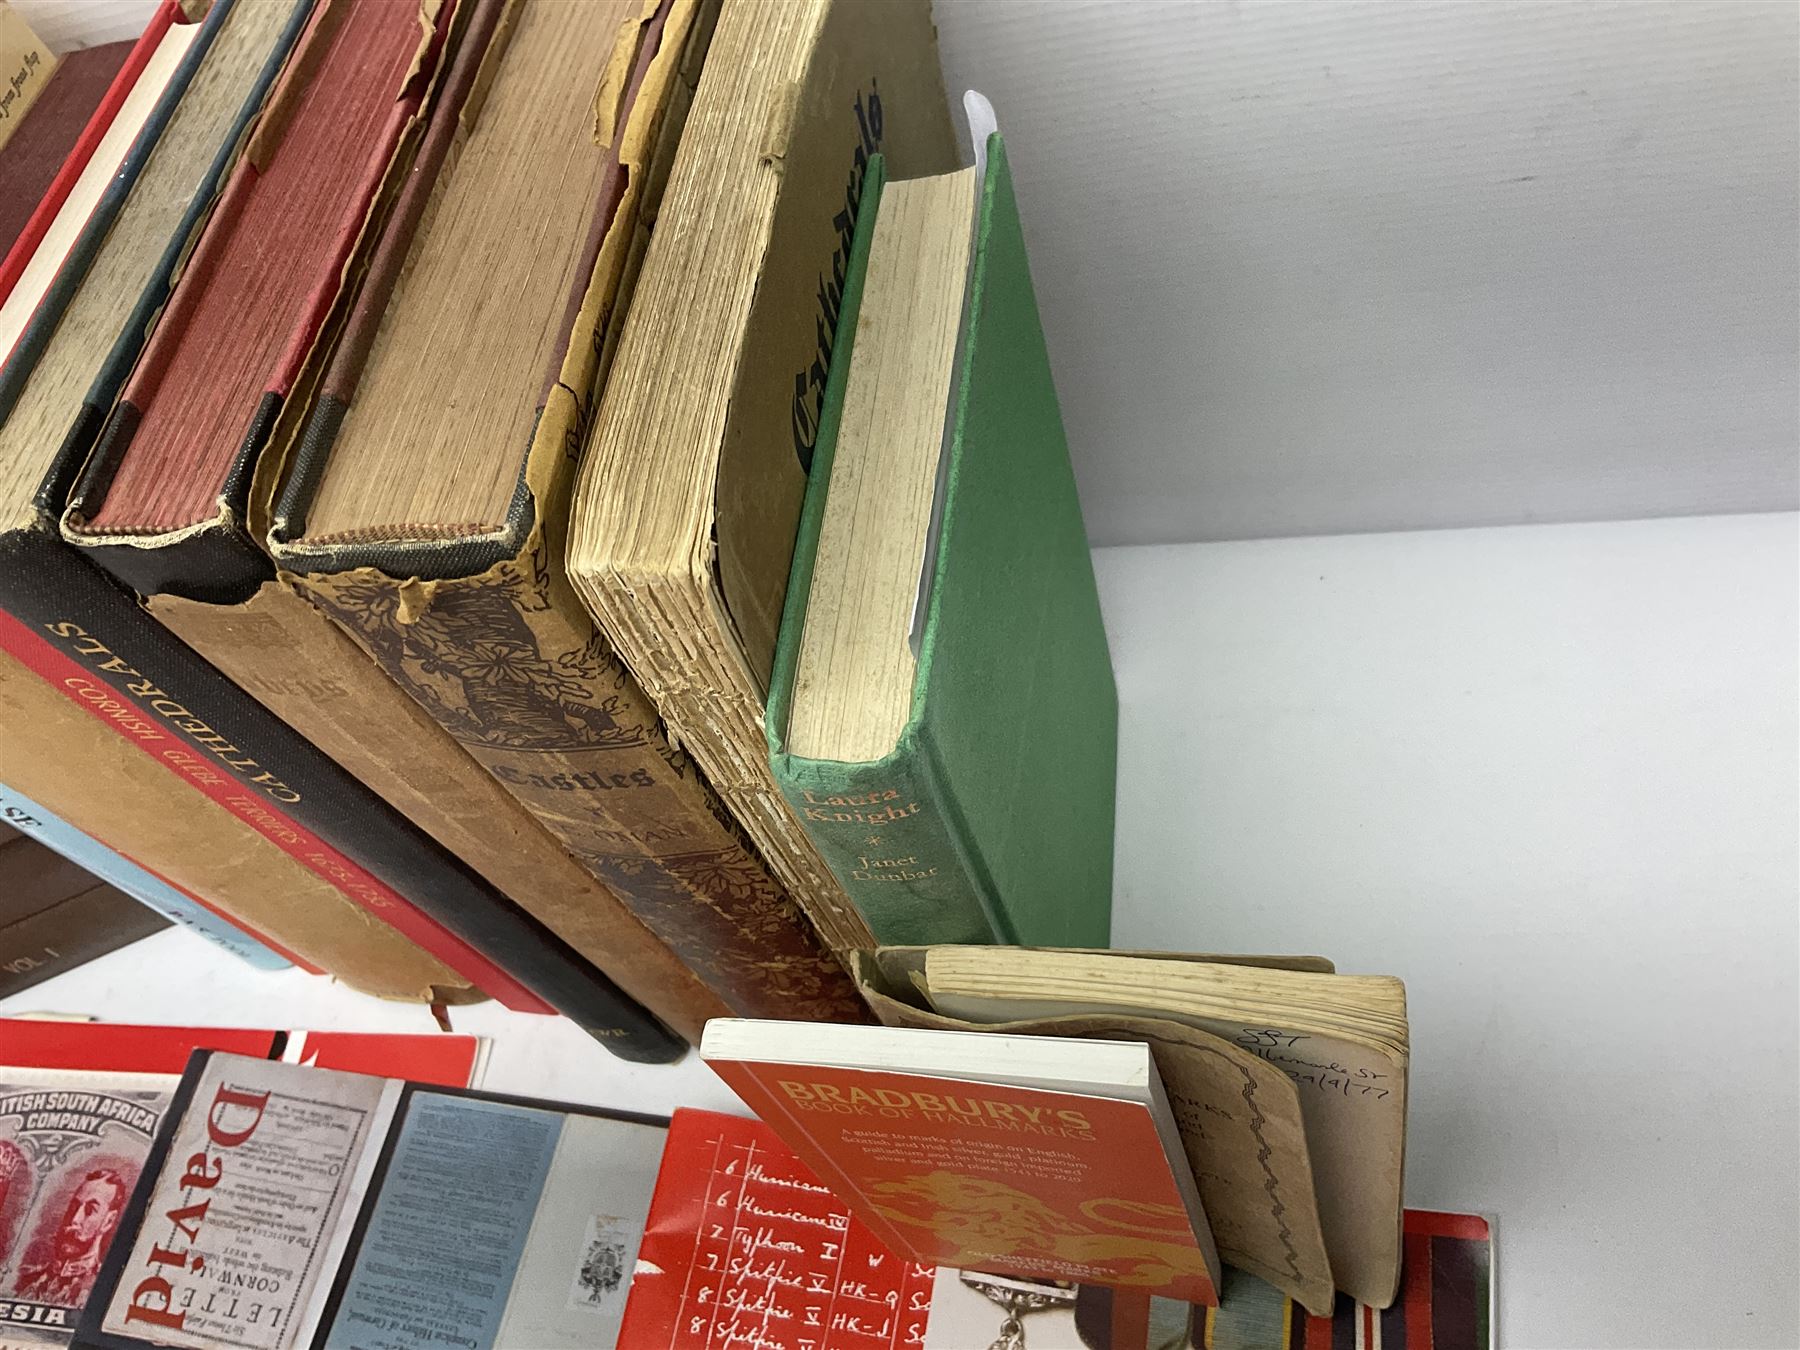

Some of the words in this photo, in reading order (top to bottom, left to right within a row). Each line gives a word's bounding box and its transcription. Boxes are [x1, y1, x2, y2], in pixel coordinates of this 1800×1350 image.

[44, 622, 300, 803] CATHEDRALS
[64, 677, 165, 741] CORNISH
[163, 749, 229, 787] GLEBE
[491, 765, 656, 791] Castles
[802, 789, 900, 806] Laura
[800, 802, 921, 825] Knight
[858, 855, 919, 870] Janet
[851, 866, 938, 881] Dunbar
[3, 957, 43, 973] VOL
[0, 1094, 46, 1114] ITISH
[46, 1093, 100, 1113] SOUTH
[98, 1098, 156, 1131] AFRICA
[777, 1080, 1092, 1132] BRADBURY'S
[27, 1112, 100, 1132] COMPANY
[794, 1100, 873, 1116] BOOK
[879, 1107, 914, 1119] OF
[921, 1110, 1097, 1142] HALLMARKS
[725, 1160, 739, 1175] 6
[124, 1081, 271, 1330] David
[716, 1191, 731, 1207] 6
[189, 1264, 280, 1293] CORNWAL
[697, 1286, 713, 1304] 8
[691, 1316, 706, 1334] 8
